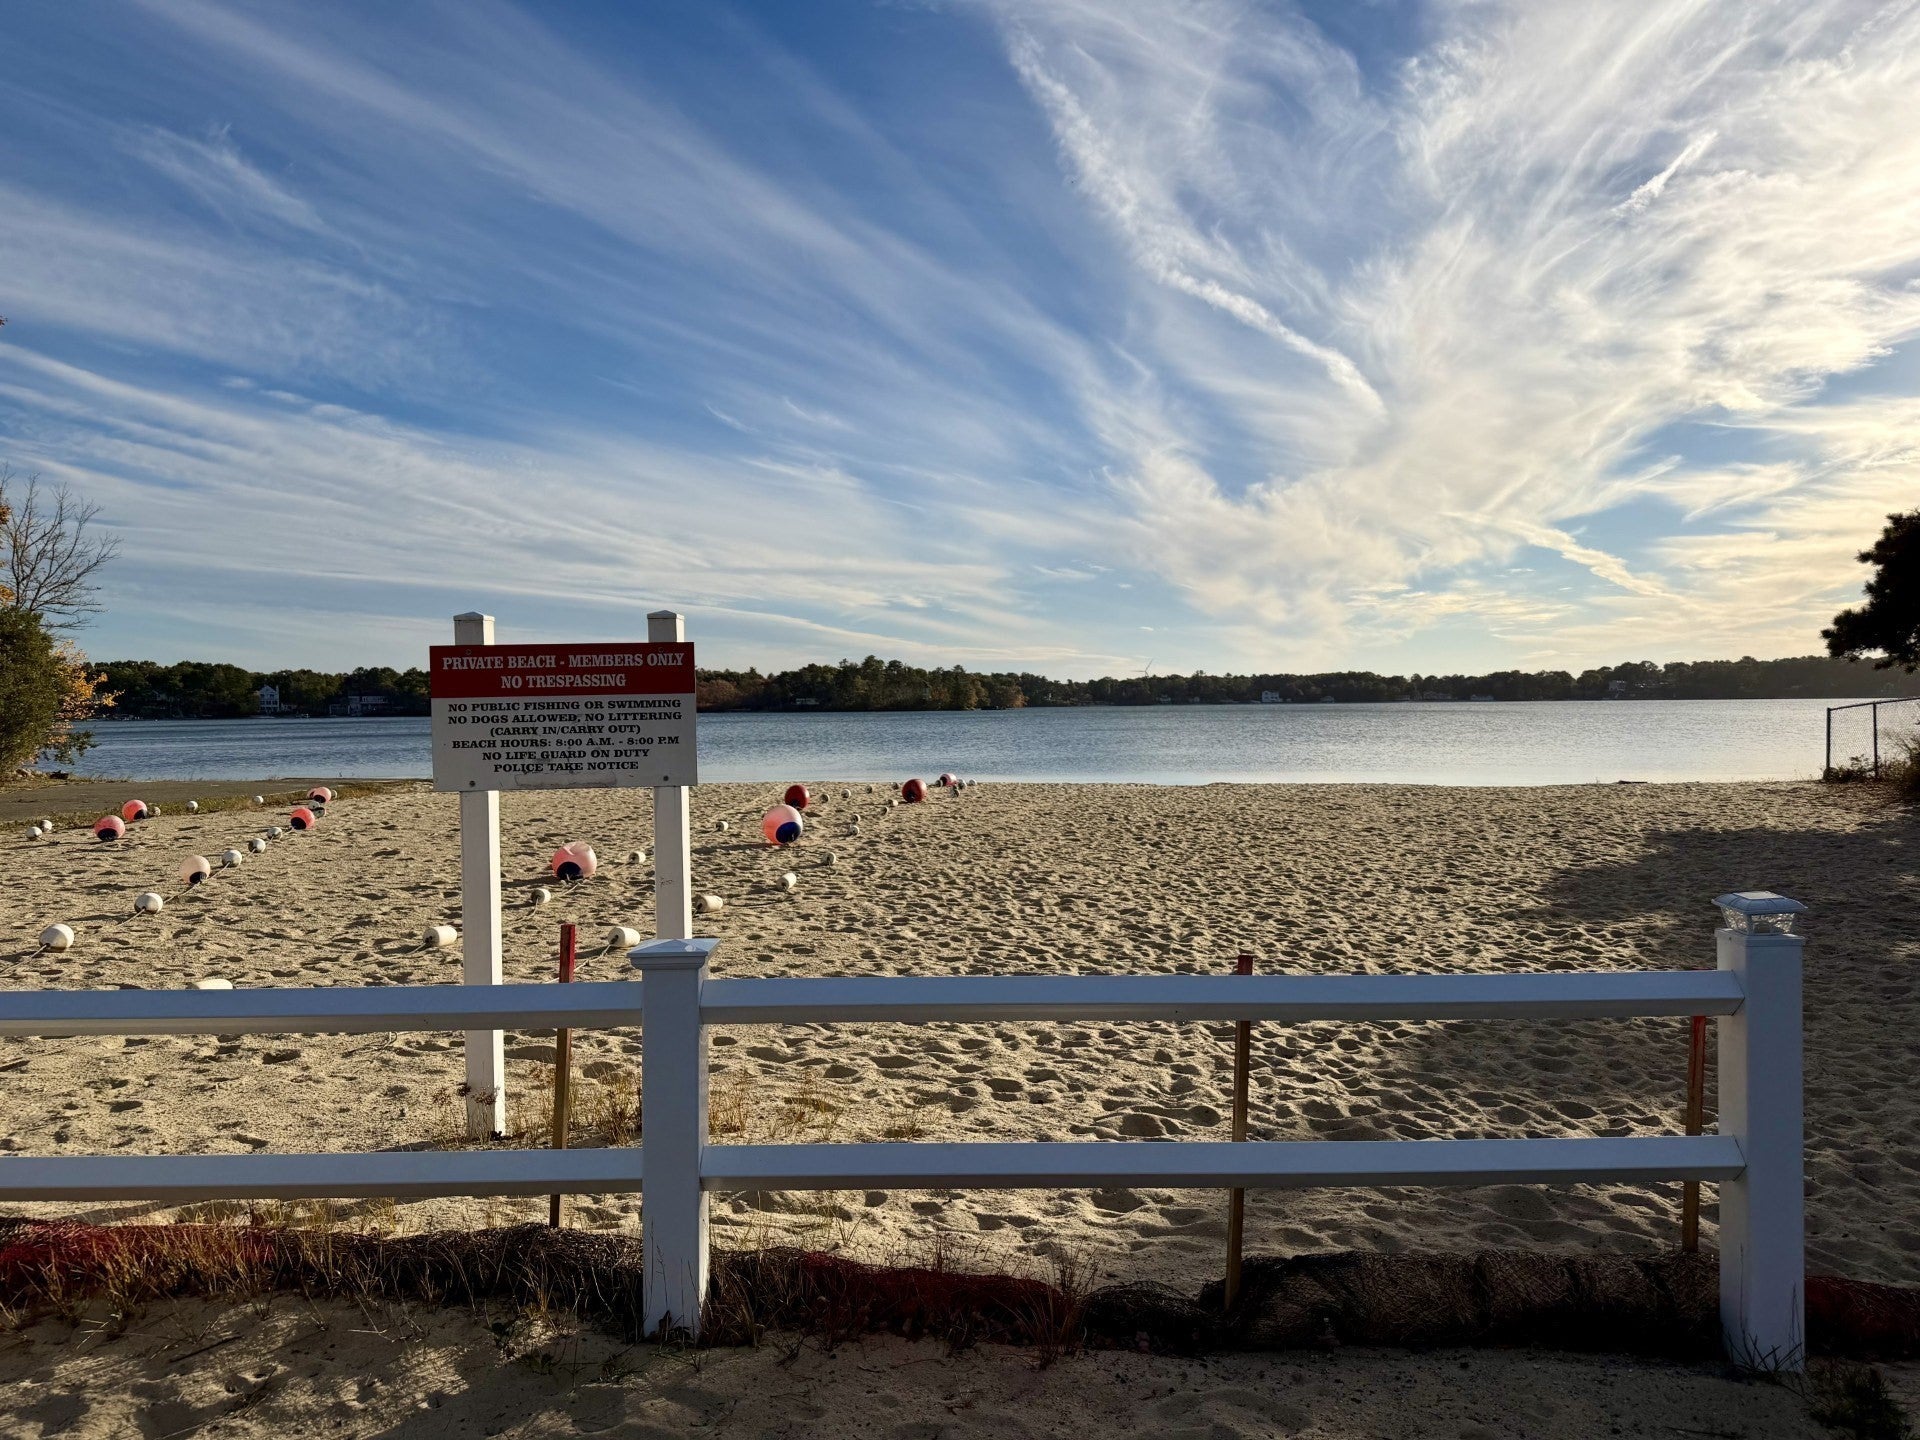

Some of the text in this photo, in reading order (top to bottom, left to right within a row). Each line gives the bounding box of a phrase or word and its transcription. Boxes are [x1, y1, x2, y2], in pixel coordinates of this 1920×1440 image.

[442, 656, 504, 670] PRIVATE
[508, 655, 556, 668] BEACH
[568, 654, 643, 668] MEMBERS
[646, 652, 684, 666] ONLY
[500, 674, 626, 688] NO TRESPASSING
[448, 700, 681, 712] NO PUBLIC FISHING OR SWIMMING
[448, 712, 682, 724] NO DOGS ALLOWED, NO LITTERING
[490, 724, 640, 737] (CARRY IN/CARRY OUT)
[452, 740, 496, 748] BEACH
[500, 738, 551, 748] HOURS:
[556, 738, 582, 746] 8:00
[586, 738, 614, 746] A.M.
[626, 737, 654, 745] 8:00
[482, 748, 650, 760] NO LIFE GUARD ON DUTY
[494, 761, 638, 772] POLICE TAKE NOTICE
